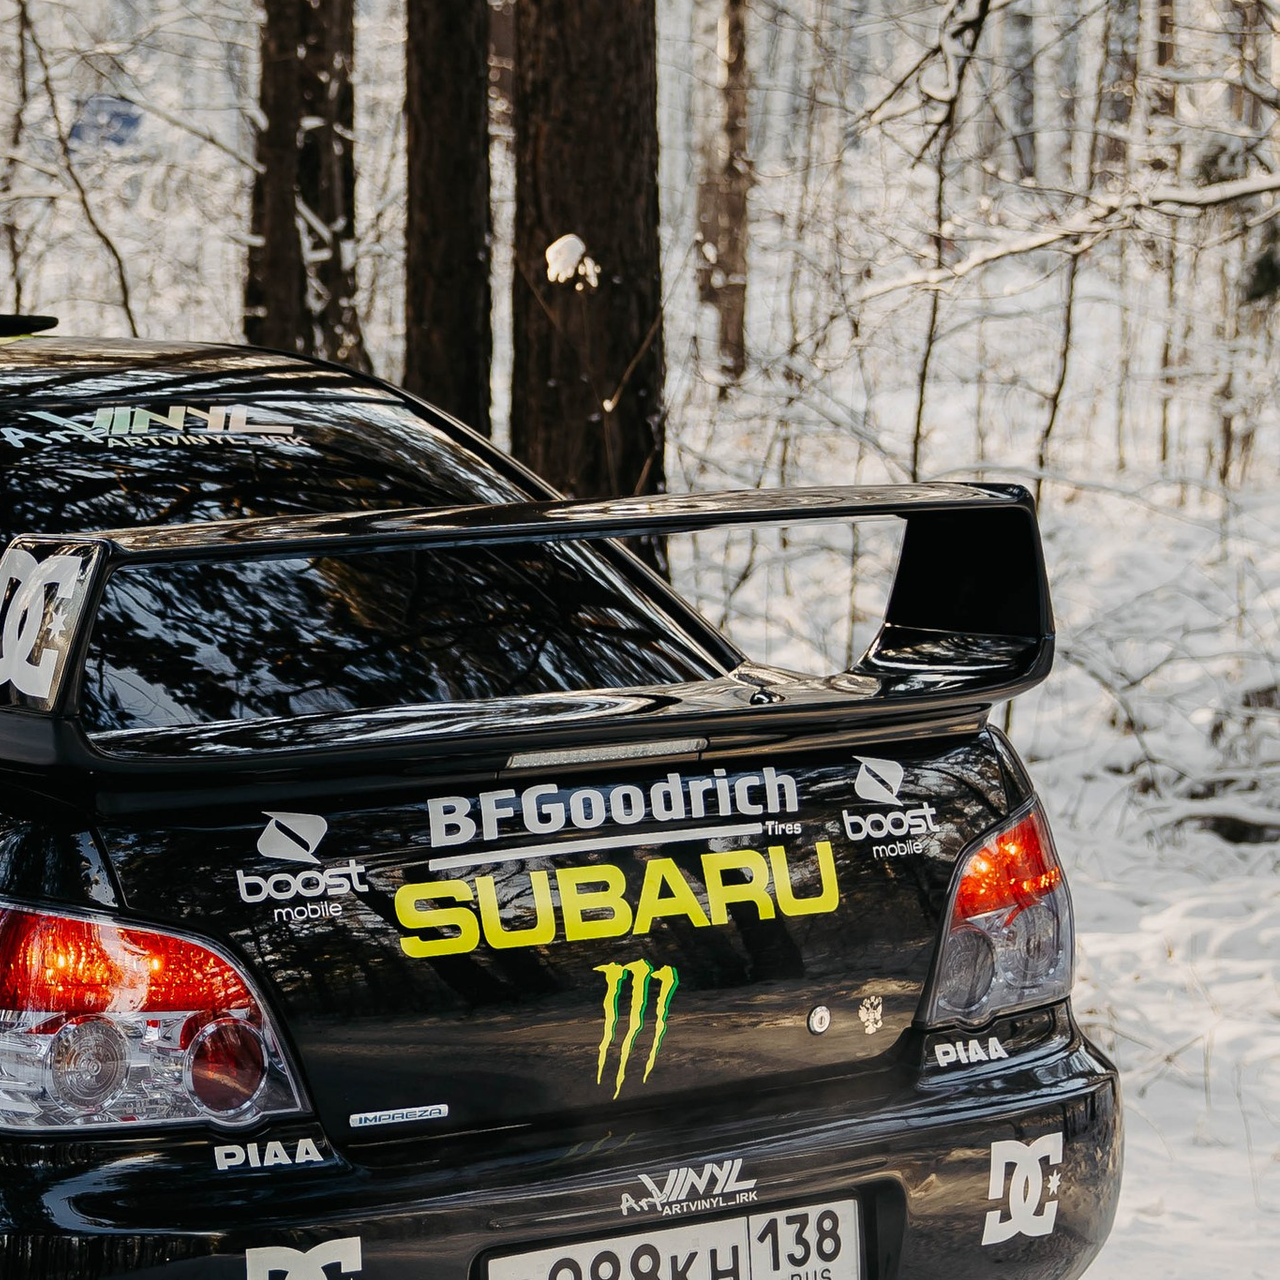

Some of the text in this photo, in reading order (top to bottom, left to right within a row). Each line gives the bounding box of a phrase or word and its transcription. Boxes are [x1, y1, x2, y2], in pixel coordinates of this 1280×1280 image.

[427, 766, 799, 849] BFGoodrich
[841, 801, 941, 841] boost
[765, 820, 802, 836] Tires
[872, 840, 923, 859] mobile
[236, 859, 369, 903] boost
[273, 901, 343, 922] mobile
[393, 840, 840, 959] SUBARU
[934, 1037, 1009, 1067] PIAA
[358, 1108, 442, 1125] IMPREZA
[214, 1138, 324, 1171] PIAA
[661, 1190, 758, 1217] ARTVINYL_IRK
[981, 1131, 1063, 1246] DC
[756, 1209, 842, 1272] 138
